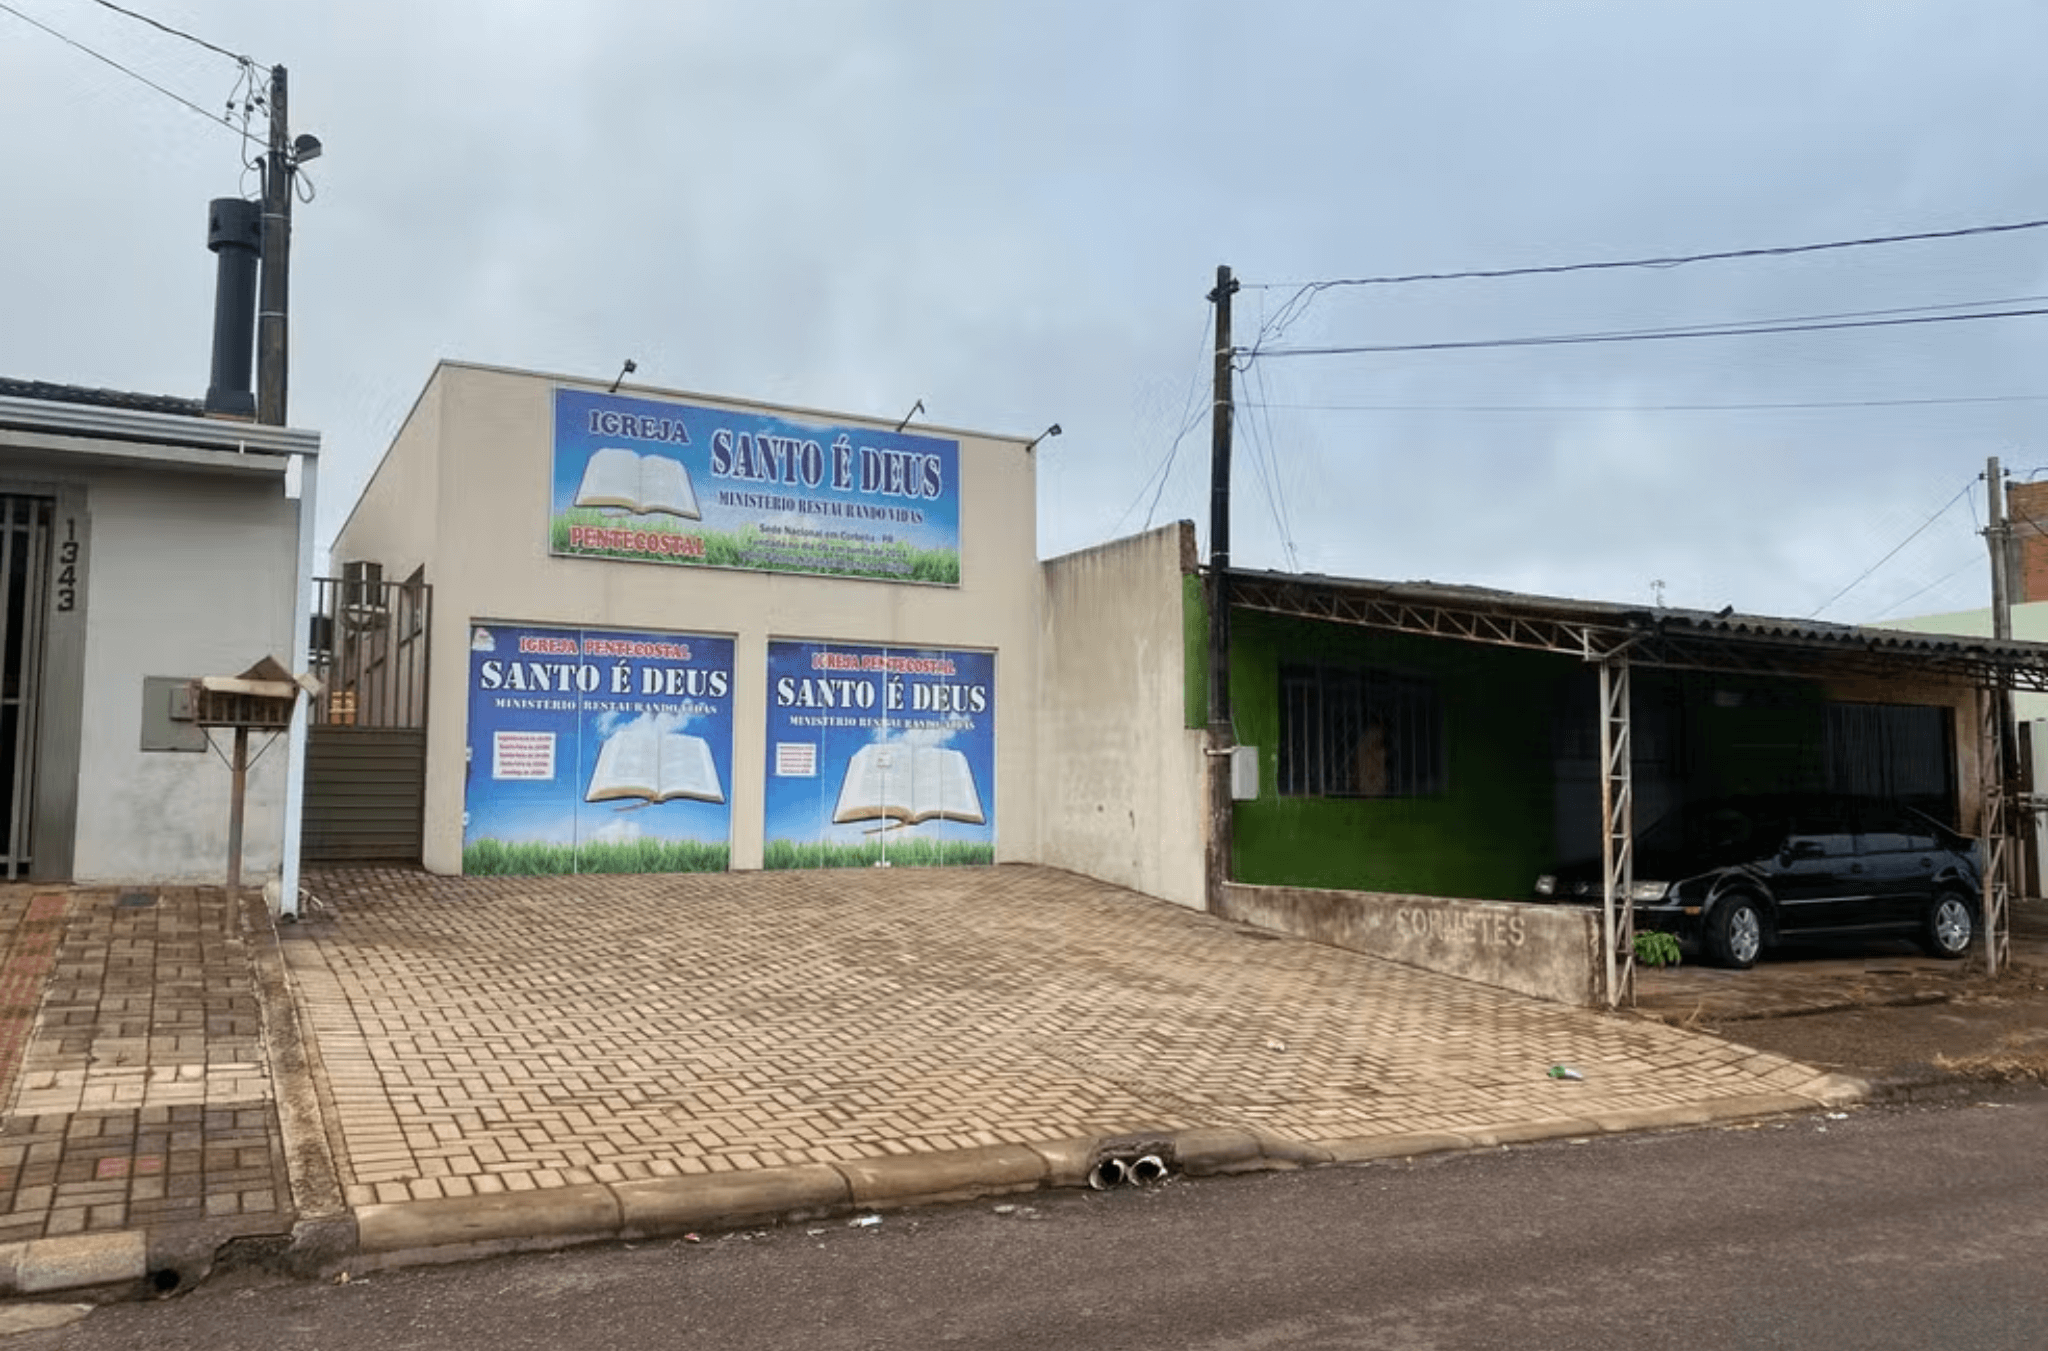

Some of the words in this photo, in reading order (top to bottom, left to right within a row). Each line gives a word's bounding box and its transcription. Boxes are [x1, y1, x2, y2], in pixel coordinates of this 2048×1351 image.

[589, 409, 691, 444] IGREJA
[710, 429, 824, 488] SANTO
[830, 434, 851, 491] É
[860, 447, 942, 499] DEUS
[798, 499, 886, 519] RESTAURANDO
[888, 507, 923, 524] VIDAS
[569, 526, 706, 556] PENTECOSTAL
[784, 525, 822, 537] Nacional
[57, 518, 79, 611] 1343
[519, 636, 578, 655] IGREJA
[584, 638, 691, 660] PENTECOSTAL
[480, 660, 600, 692] SANTO
[610, 659, 631, 693] É
[641, 666, 728, 698] DEUS
[861, 655, 955, 675] PENTECOSTAL
[777, 677, 875, 709] SANTO
[887, 674, 904, 710] É
[912, 683, 986, 713] DEUS
